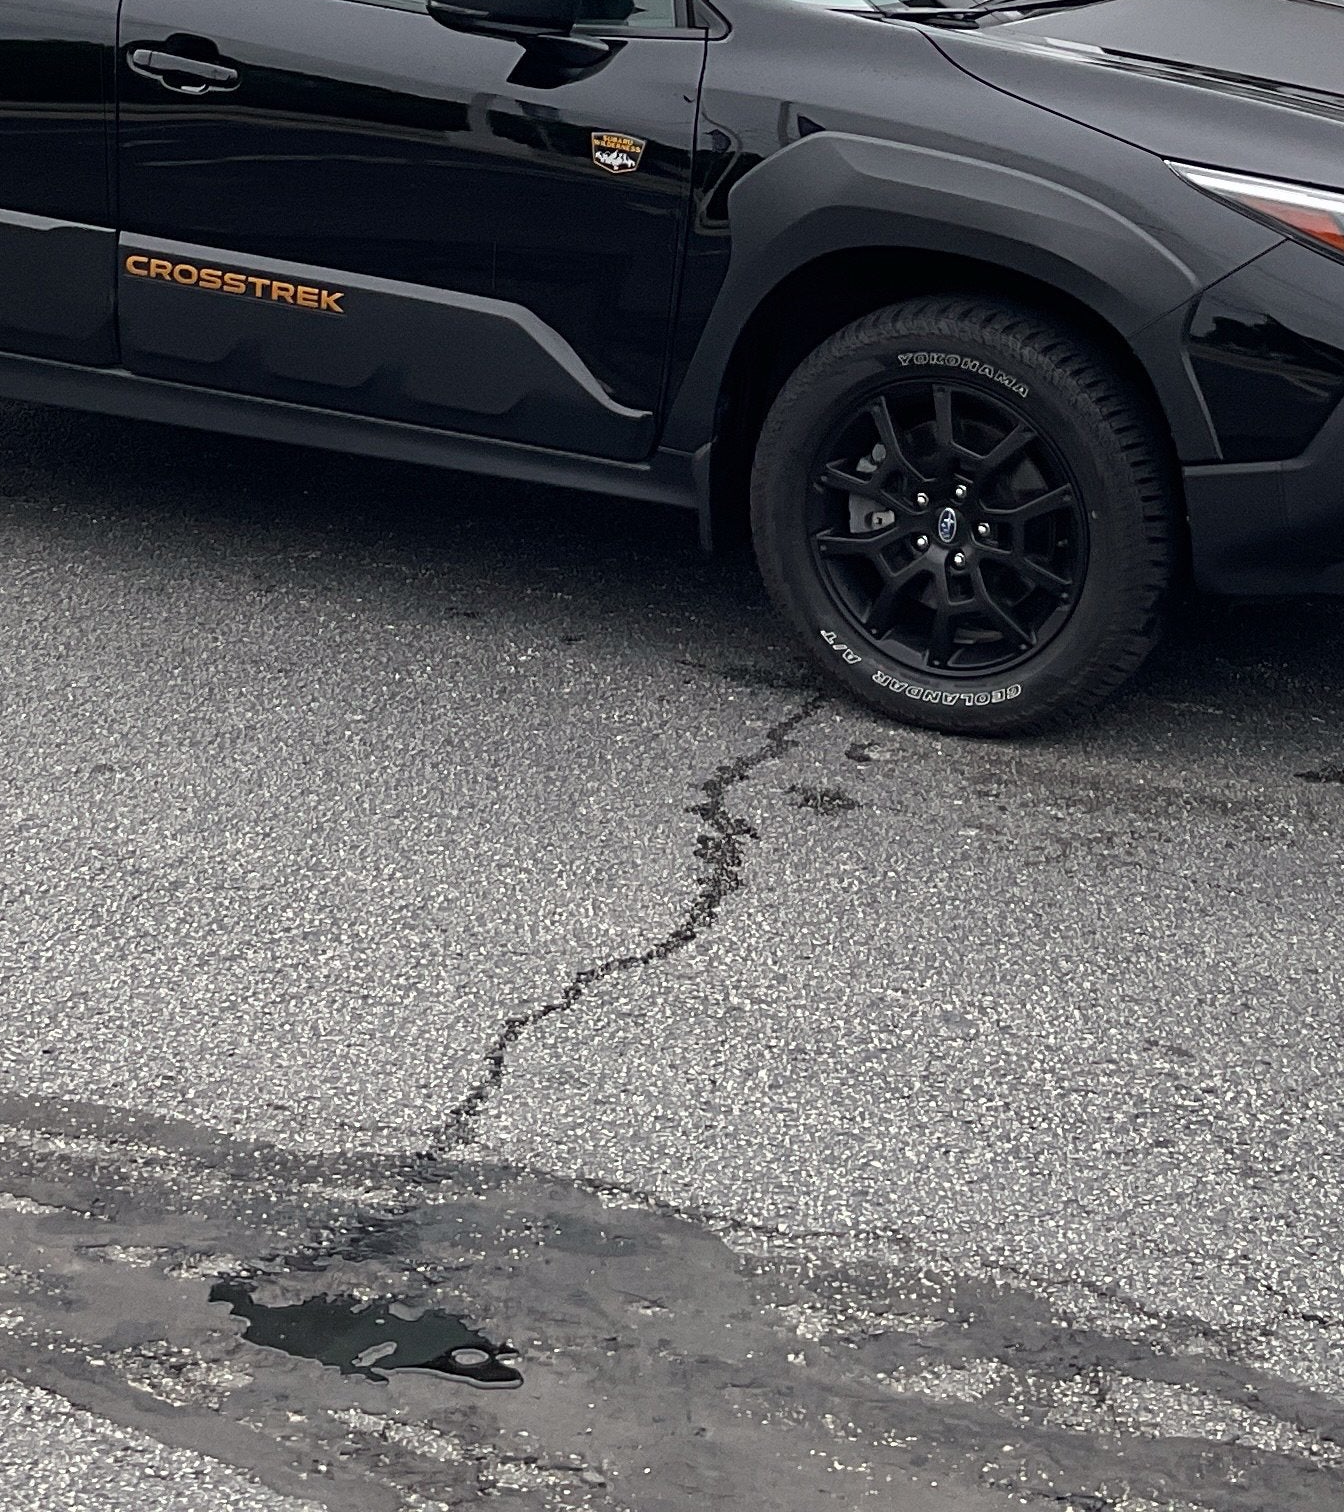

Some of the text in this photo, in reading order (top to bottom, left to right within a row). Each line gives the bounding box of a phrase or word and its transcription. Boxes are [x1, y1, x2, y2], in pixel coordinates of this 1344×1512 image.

[124, 254, 345, 314] CROSSTREK
[898, 351, 1030, 398] YOKOHAMA
[820, 629, 1023, 706] GEOLANDAR A/T
